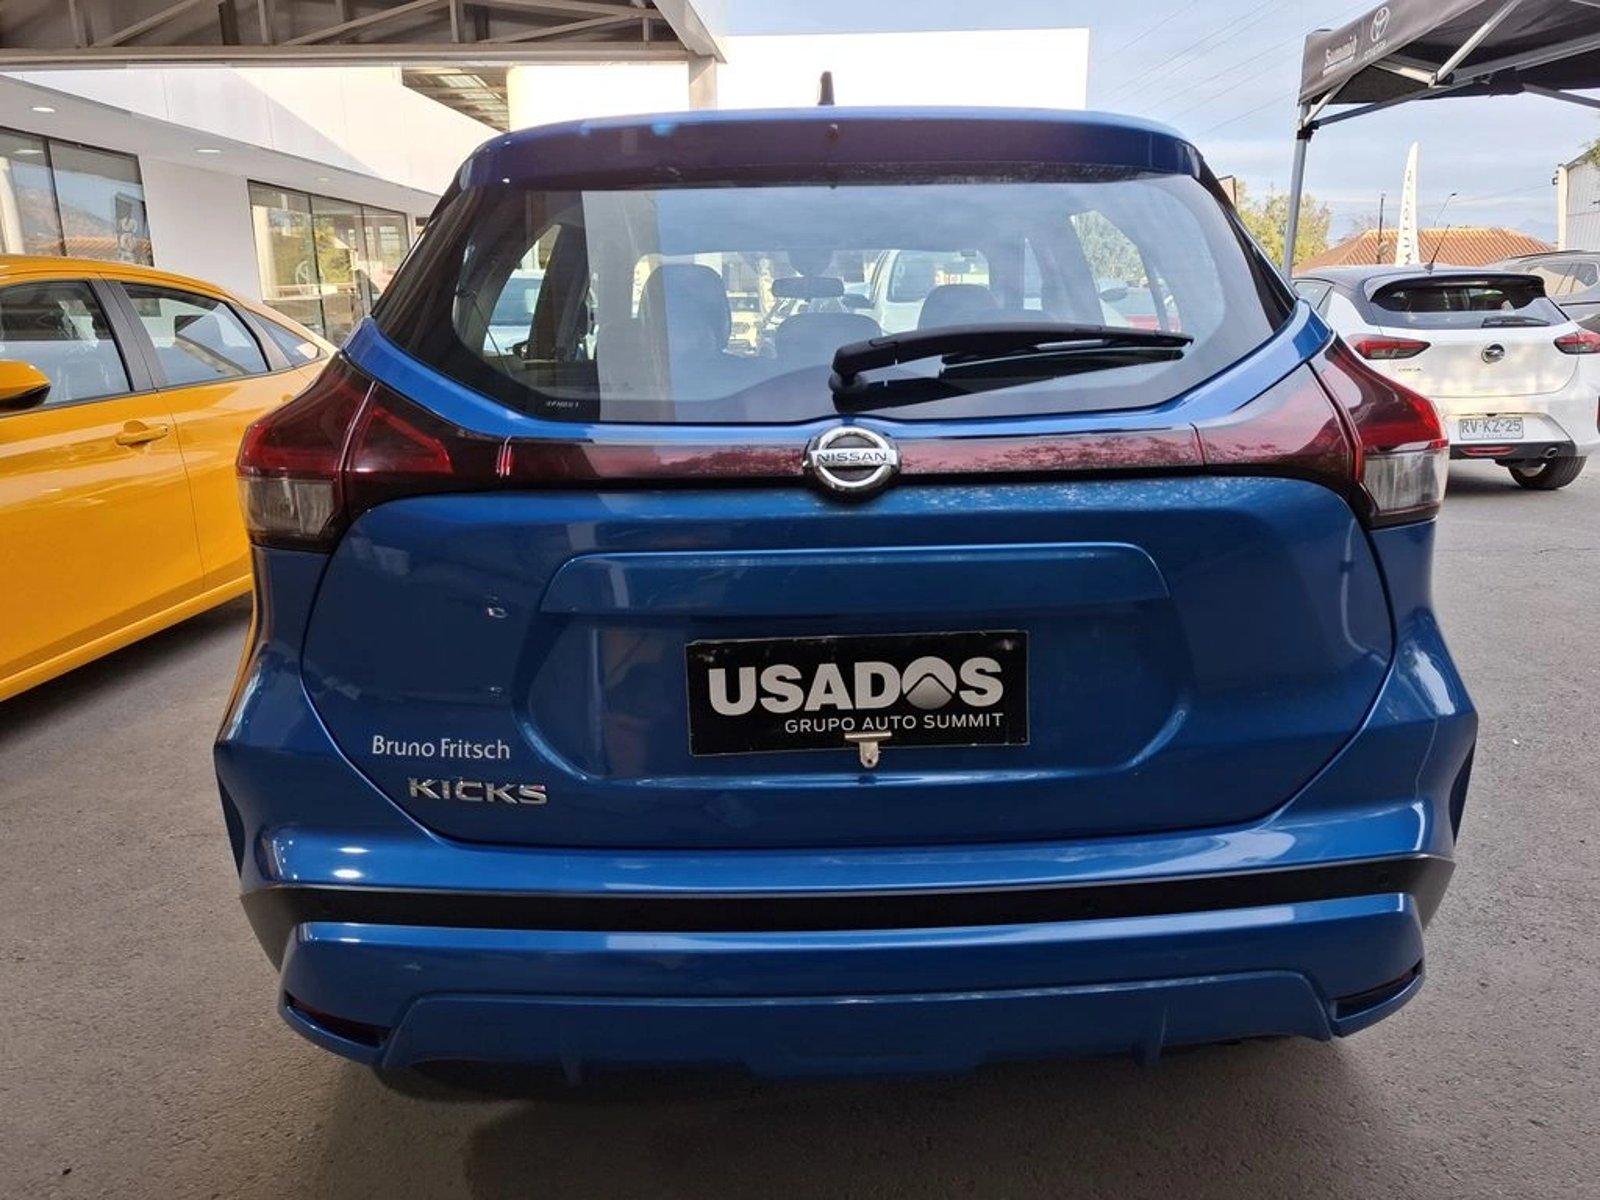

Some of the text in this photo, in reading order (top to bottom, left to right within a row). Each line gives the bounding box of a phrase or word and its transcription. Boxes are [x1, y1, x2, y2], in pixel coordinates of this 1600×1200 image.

[816, 452, 887, 462] NISSAN
[708, 655, 1004, 717] USADOS
[784, 713, 1004, 734] GRUPO AUTO SUMMIT
[372, 735, 511, 760] Bruno Fritsch
[407, 777, 548, 805] KICKS
